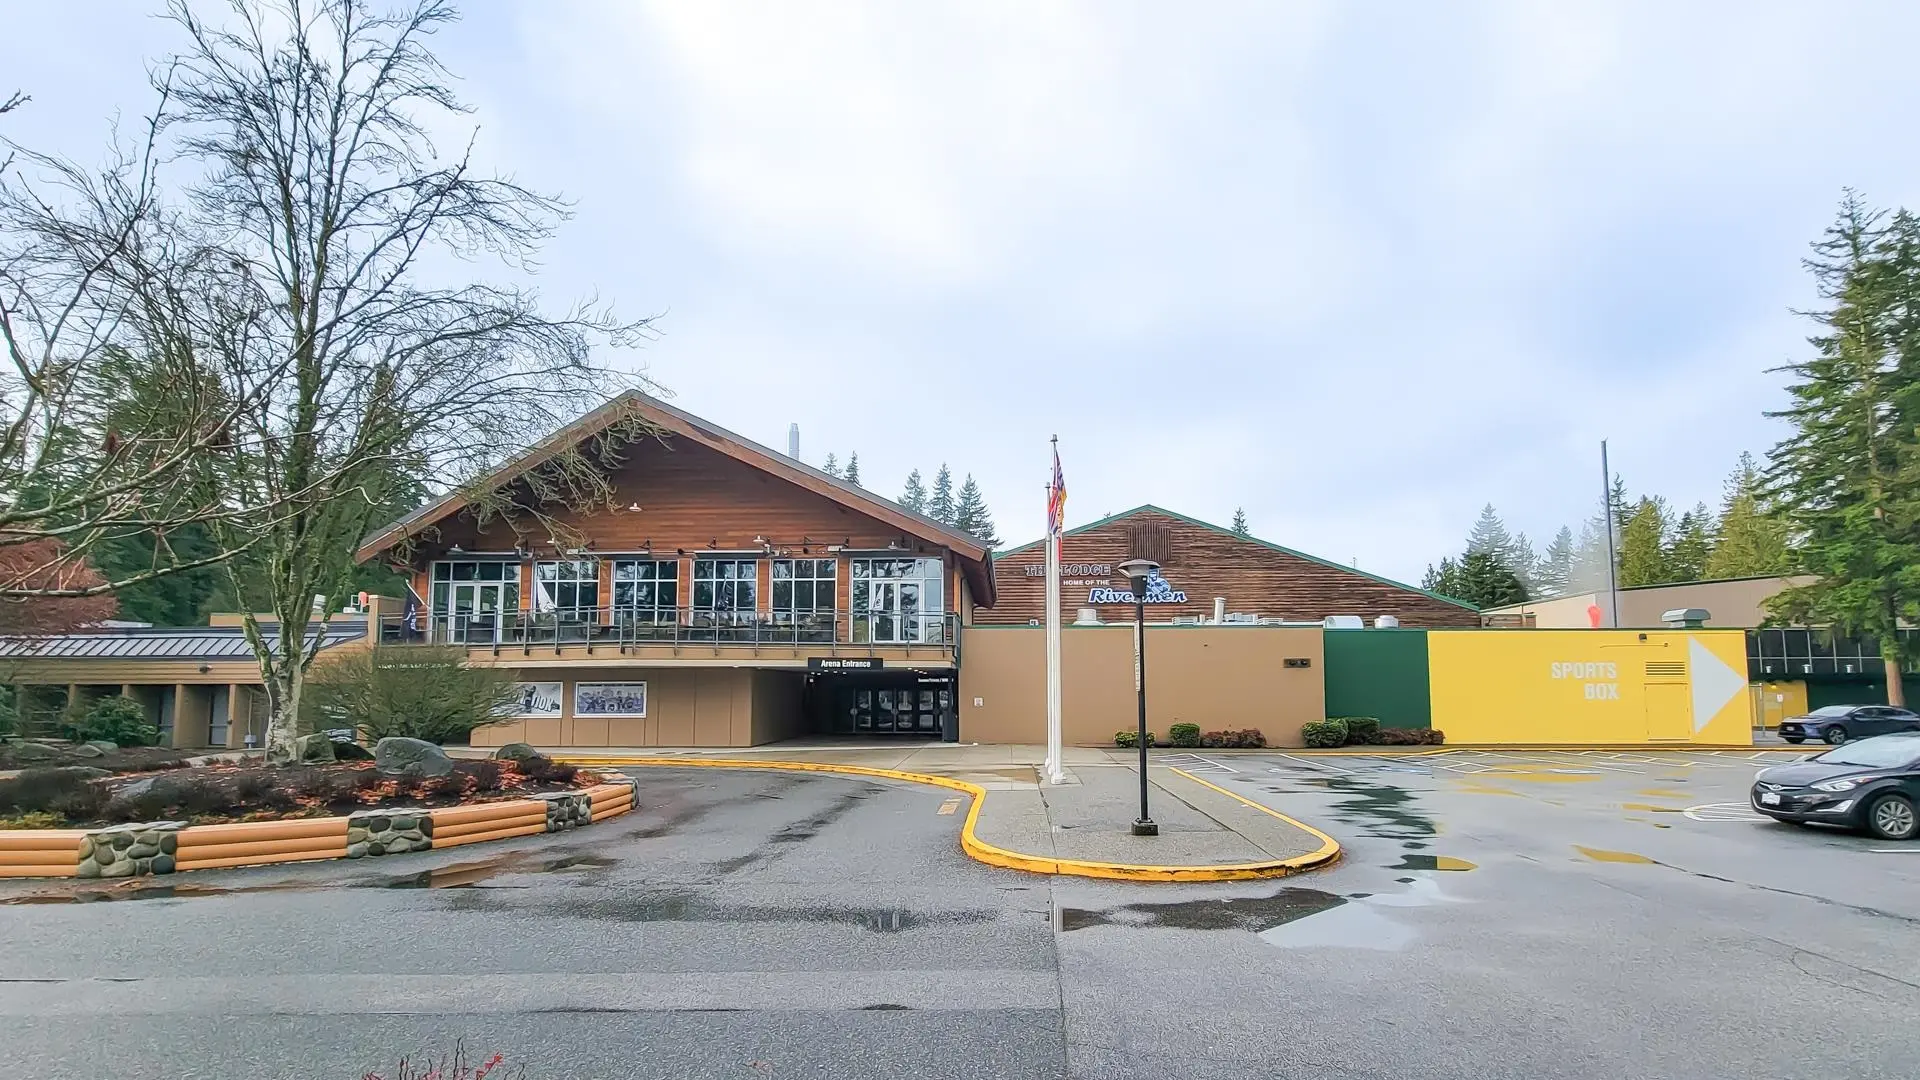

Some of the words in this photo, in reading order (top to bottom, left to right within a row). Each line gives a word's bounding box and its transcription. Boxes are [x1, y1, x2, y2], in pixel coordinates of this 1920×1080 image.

[1025, 565, 1048, 576] TH
[1060, 564, 1111, 576] LODGE
[1088, 588, 1187, 603] Rivemen
[1551, 662, 1617, 679] SPORTS
[1584, 683, 1620, 700] BOX
